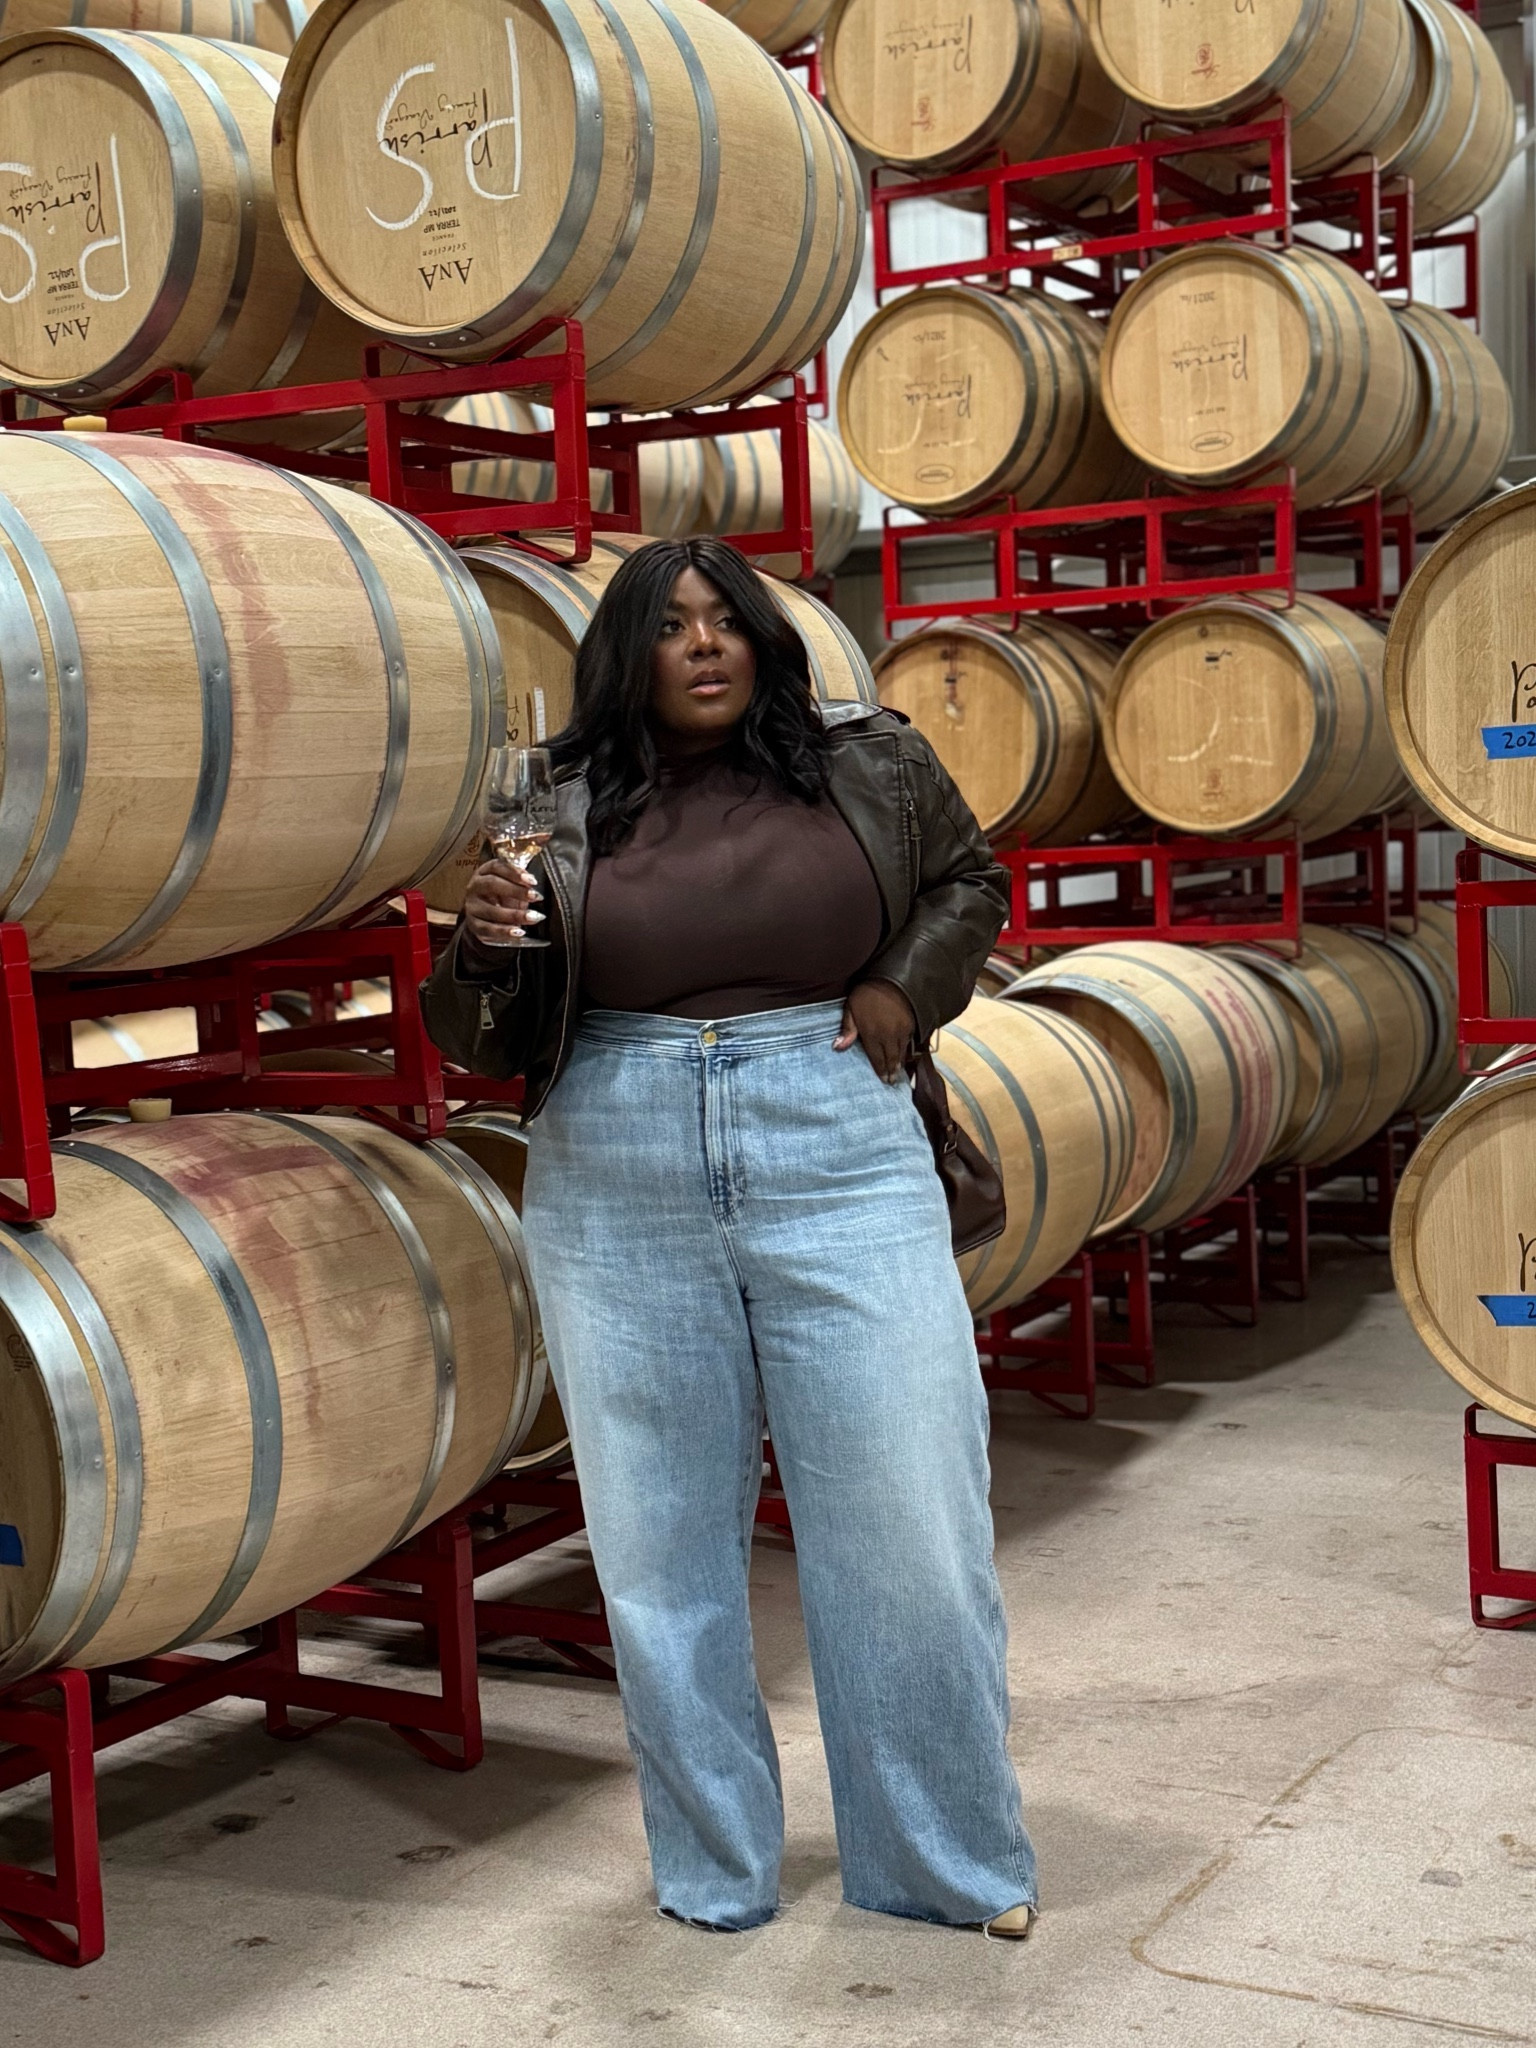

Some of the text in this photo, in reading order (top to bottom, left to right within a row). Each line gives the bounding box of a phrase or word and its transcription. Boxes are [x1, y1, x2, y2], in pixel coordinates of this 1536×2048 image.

[5, 160, 106, 236] Parrish
[423, 218, 461, 234] TERRA MP
[421, 242, 468, 257] Selection
[46, 280, 80, 295] TERRA MP
[46, 302, 86, 316] Selection
